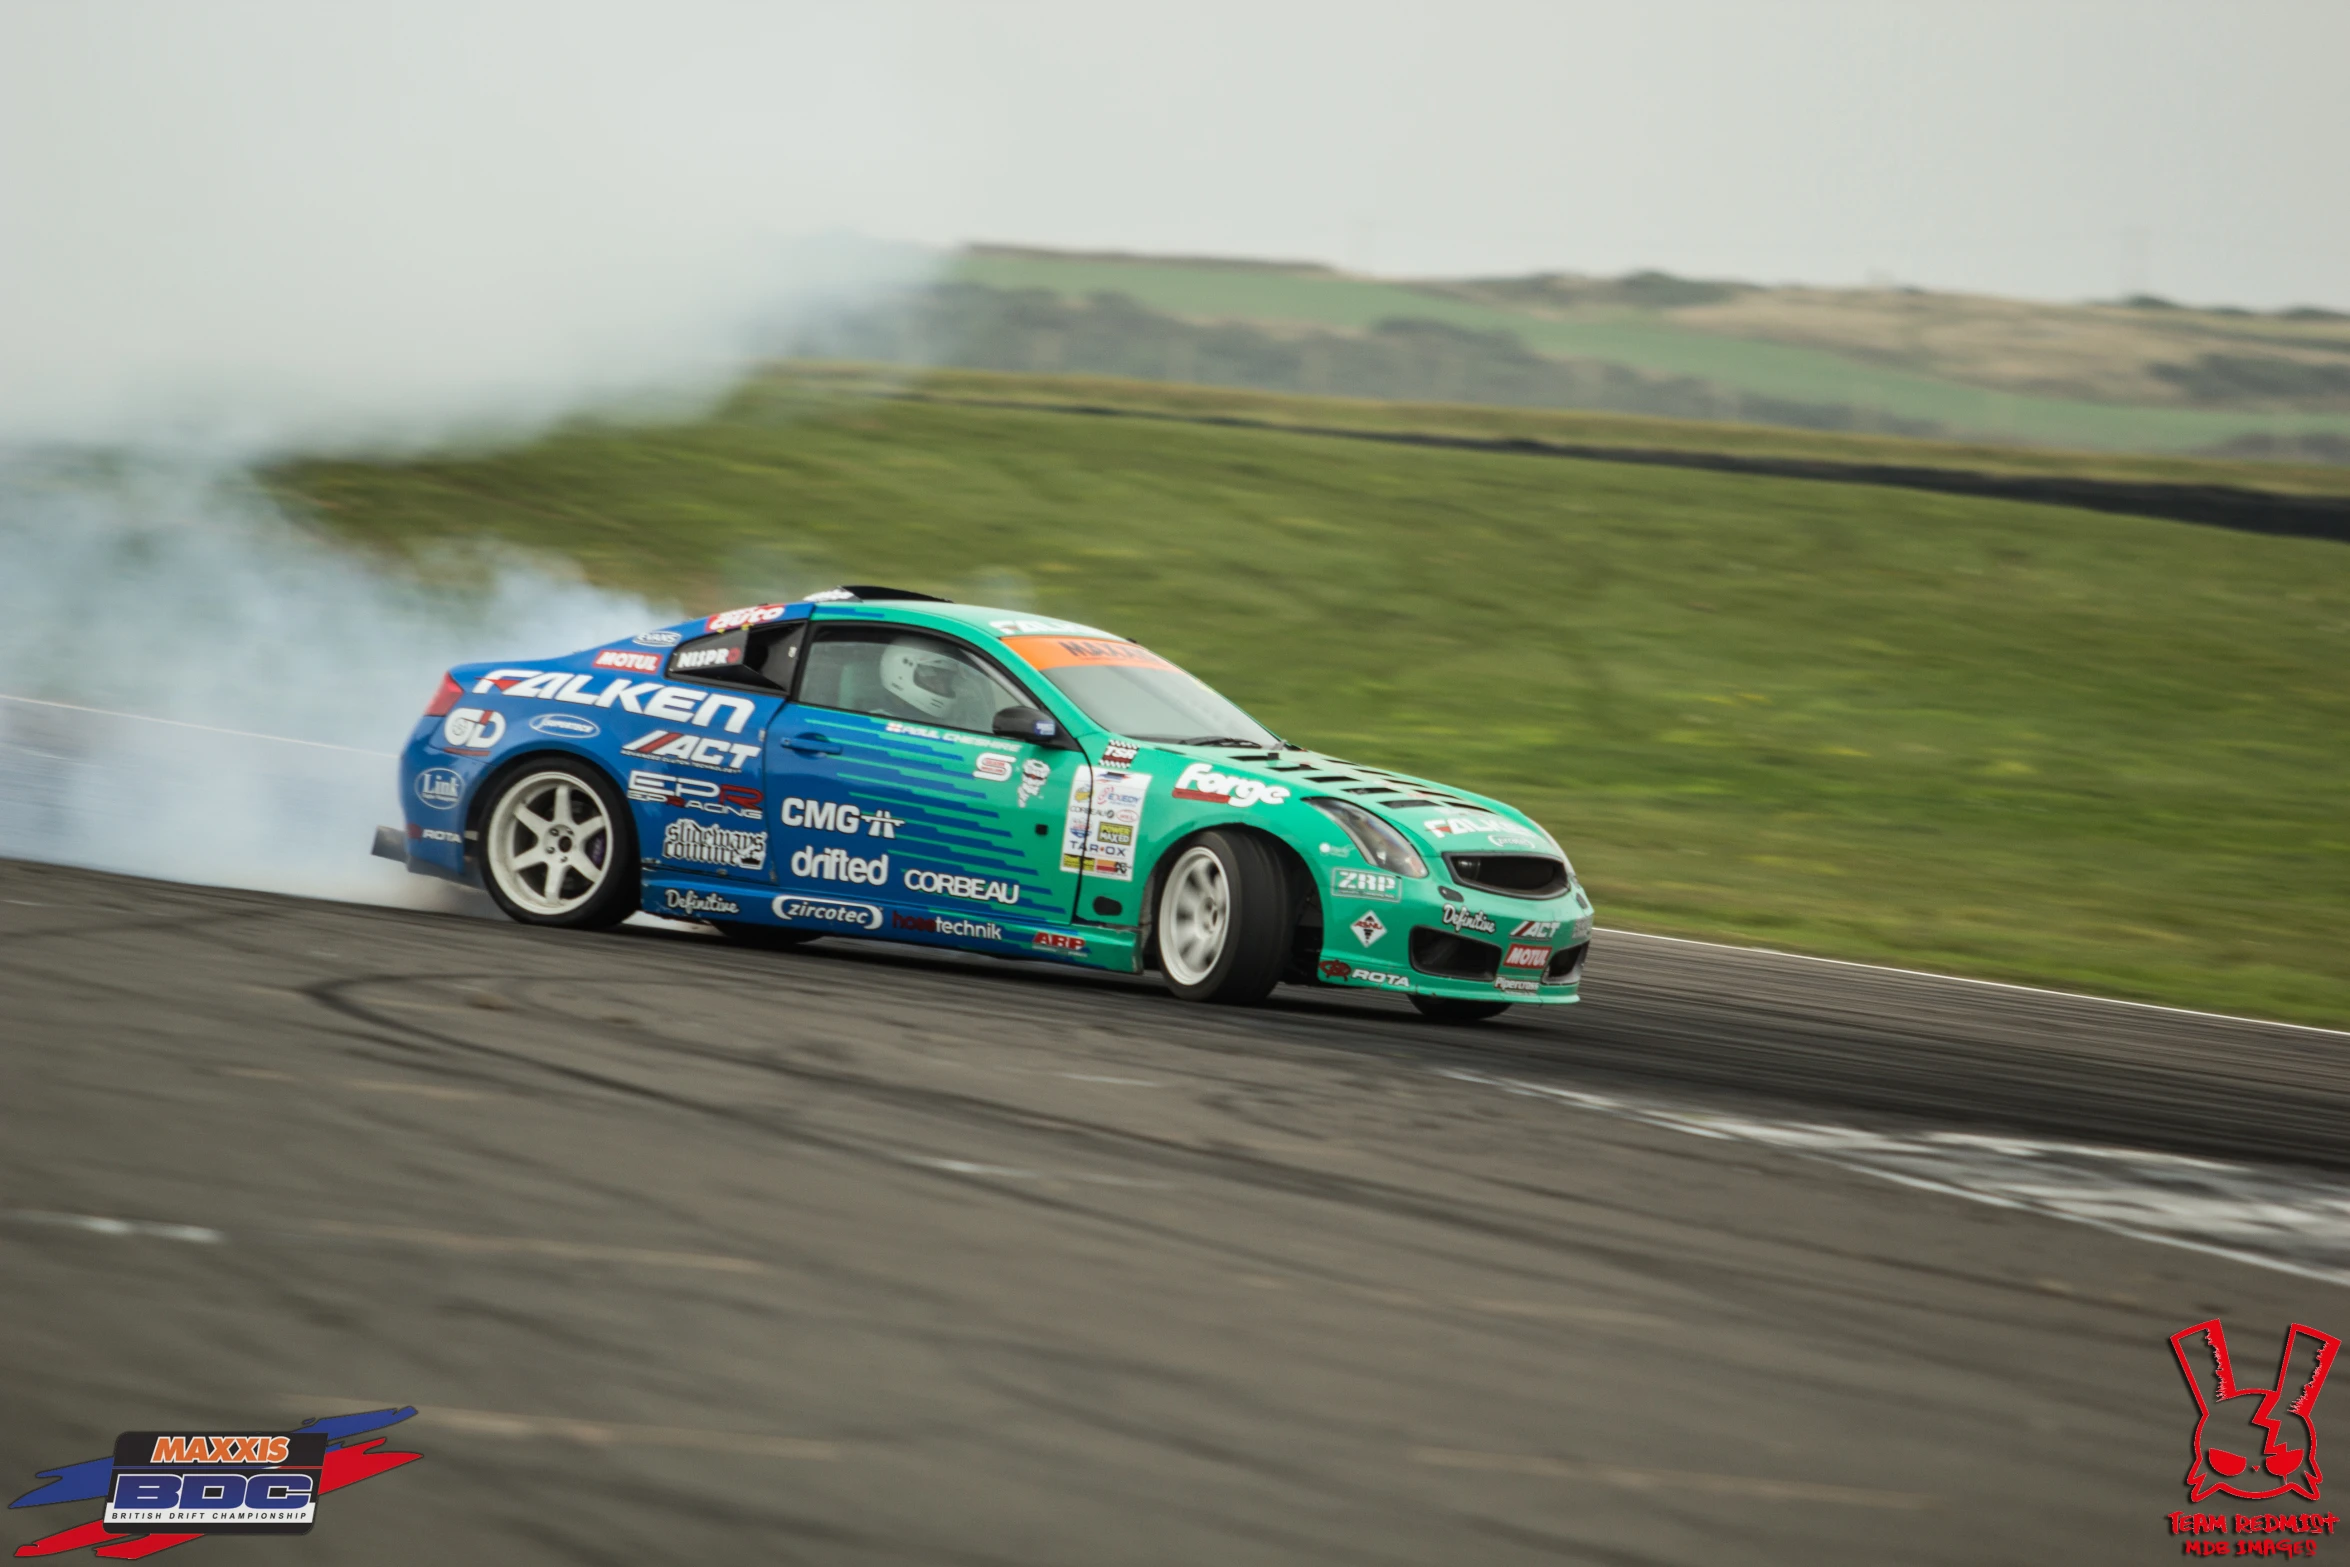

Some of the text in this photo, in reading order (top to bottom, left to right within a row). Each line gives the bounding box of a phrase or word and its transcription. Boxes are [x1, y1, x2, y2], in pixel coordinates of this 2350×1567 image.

[636, 631, 678, 645] EVANS
[595, 652, 658, 671] MOTUL
[472, 669, 755, 734] FALKEN
[422, 772, 459, 795] Link
[628, 770, 764, 811] EPR
[1174, 762, 1291, 808] Forge
[781, 797, 860, 834] CMG
[422, 829, 462, 843] ROTA
[791, 845, 889, 886] drifted
[904, 869, 1020, 904] CORBEAU
[1339, 871, 1396, 892] ZRP
[665, 889, 740, 914] Definitive
[788, 902, 868, 925] zircotec
[892, 910, 1002, 940] hosetechnik
[1443, 903, 1496, 933] Definitive
[1033, 932, 1086, 950] ARP
[1506, 947, 1549, 966] MOTUL
[1352, 969, 1410, 987] ROTA
[1495, 977, 1540, 991] Pipercross
